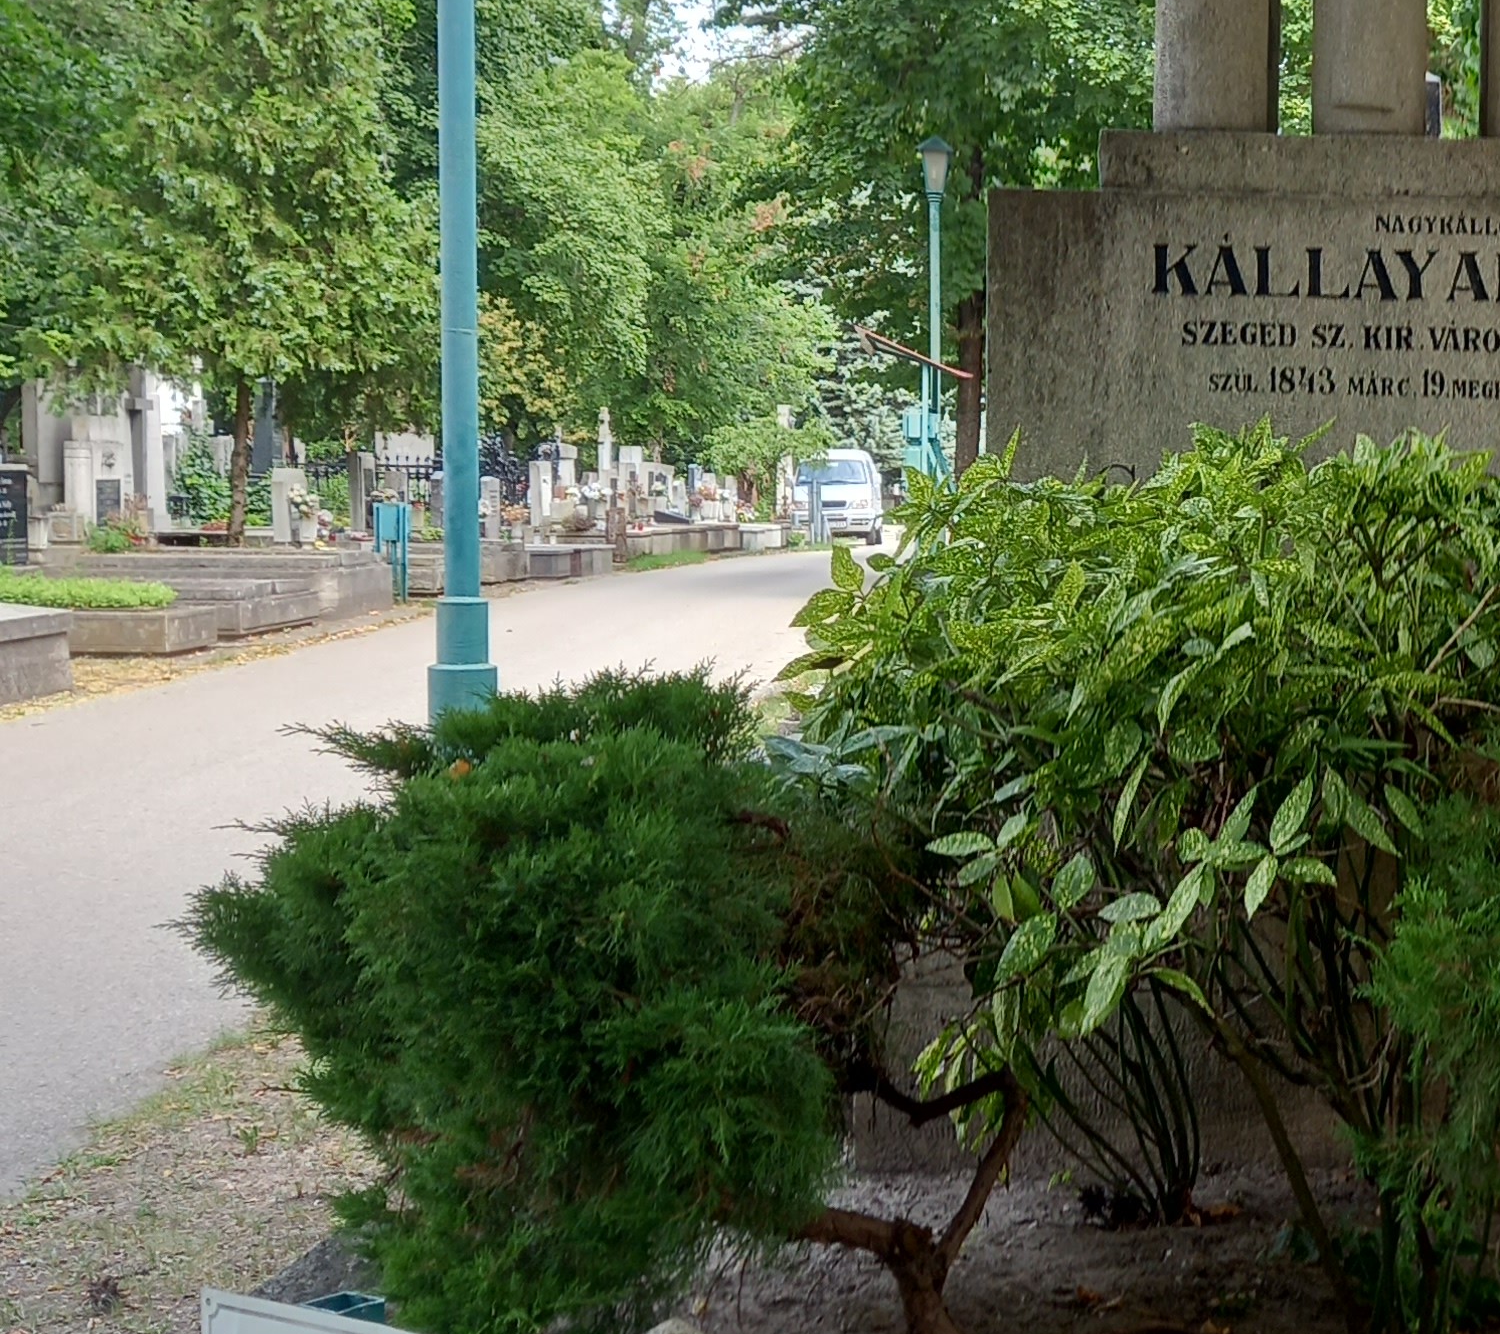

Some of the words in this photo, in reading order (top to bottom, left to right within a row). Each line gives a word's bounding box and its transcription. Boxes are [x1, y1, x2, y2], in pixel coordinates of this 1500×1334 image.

[1152, 232, 1440, 301] KÁLLAY
[1181, 319, 1298, 349] SZEGED
[1311, 323, 1354, 350] SZ.
[1269, 365, 1337, 396] 1843
